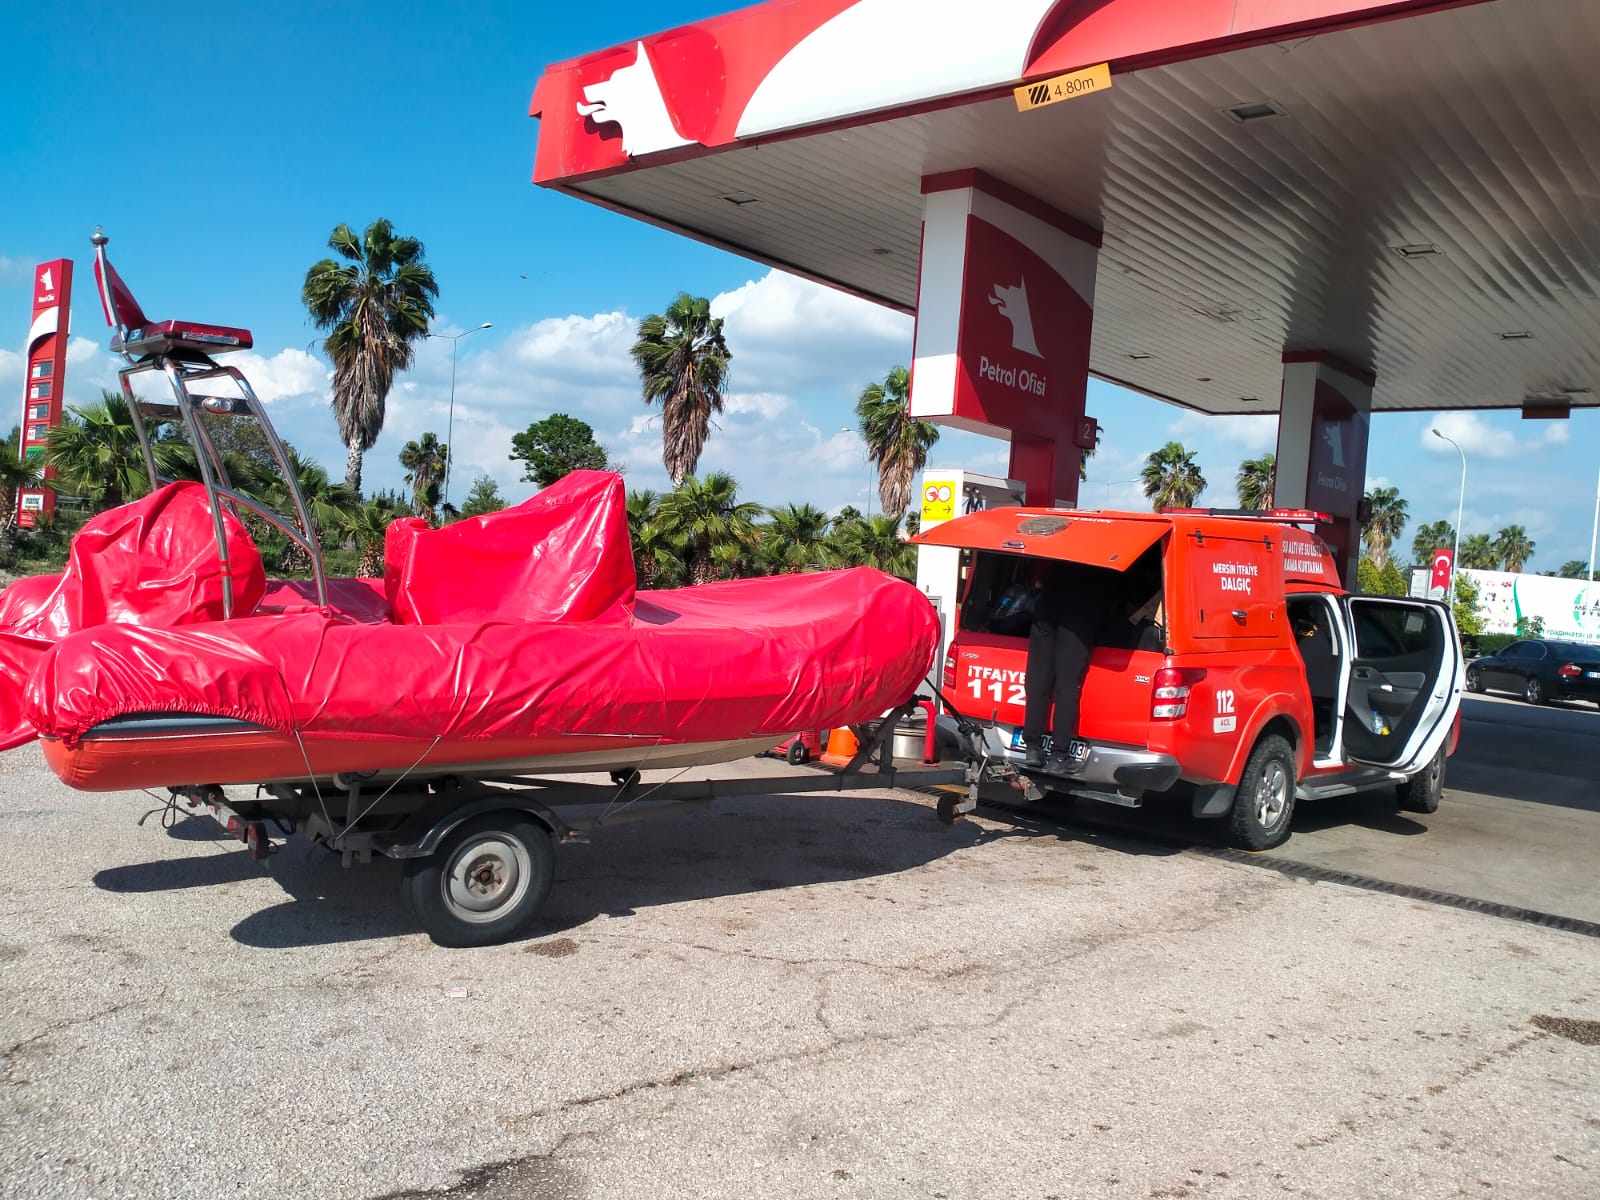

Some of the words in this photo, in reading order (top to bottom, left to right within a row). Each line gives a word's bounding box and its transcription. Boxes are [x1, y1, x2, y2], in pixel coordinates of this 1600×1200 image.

[1054, 78, 1094, 97] 4.80m
[979, 355, 1017, 388] Petrol
[1018, 369, 1047, 397] Ofisi
[1083, 423, 1092, 439] 2
[1213, 561, 1236, 575] MERSİN
[1236, 561, 1258, 576] İTFAİYE
[1221, 577, 1251, 595] DALGIÇ
[967, 678, 1027, 706] 112
[1216, 690, 1235, 714] 112
